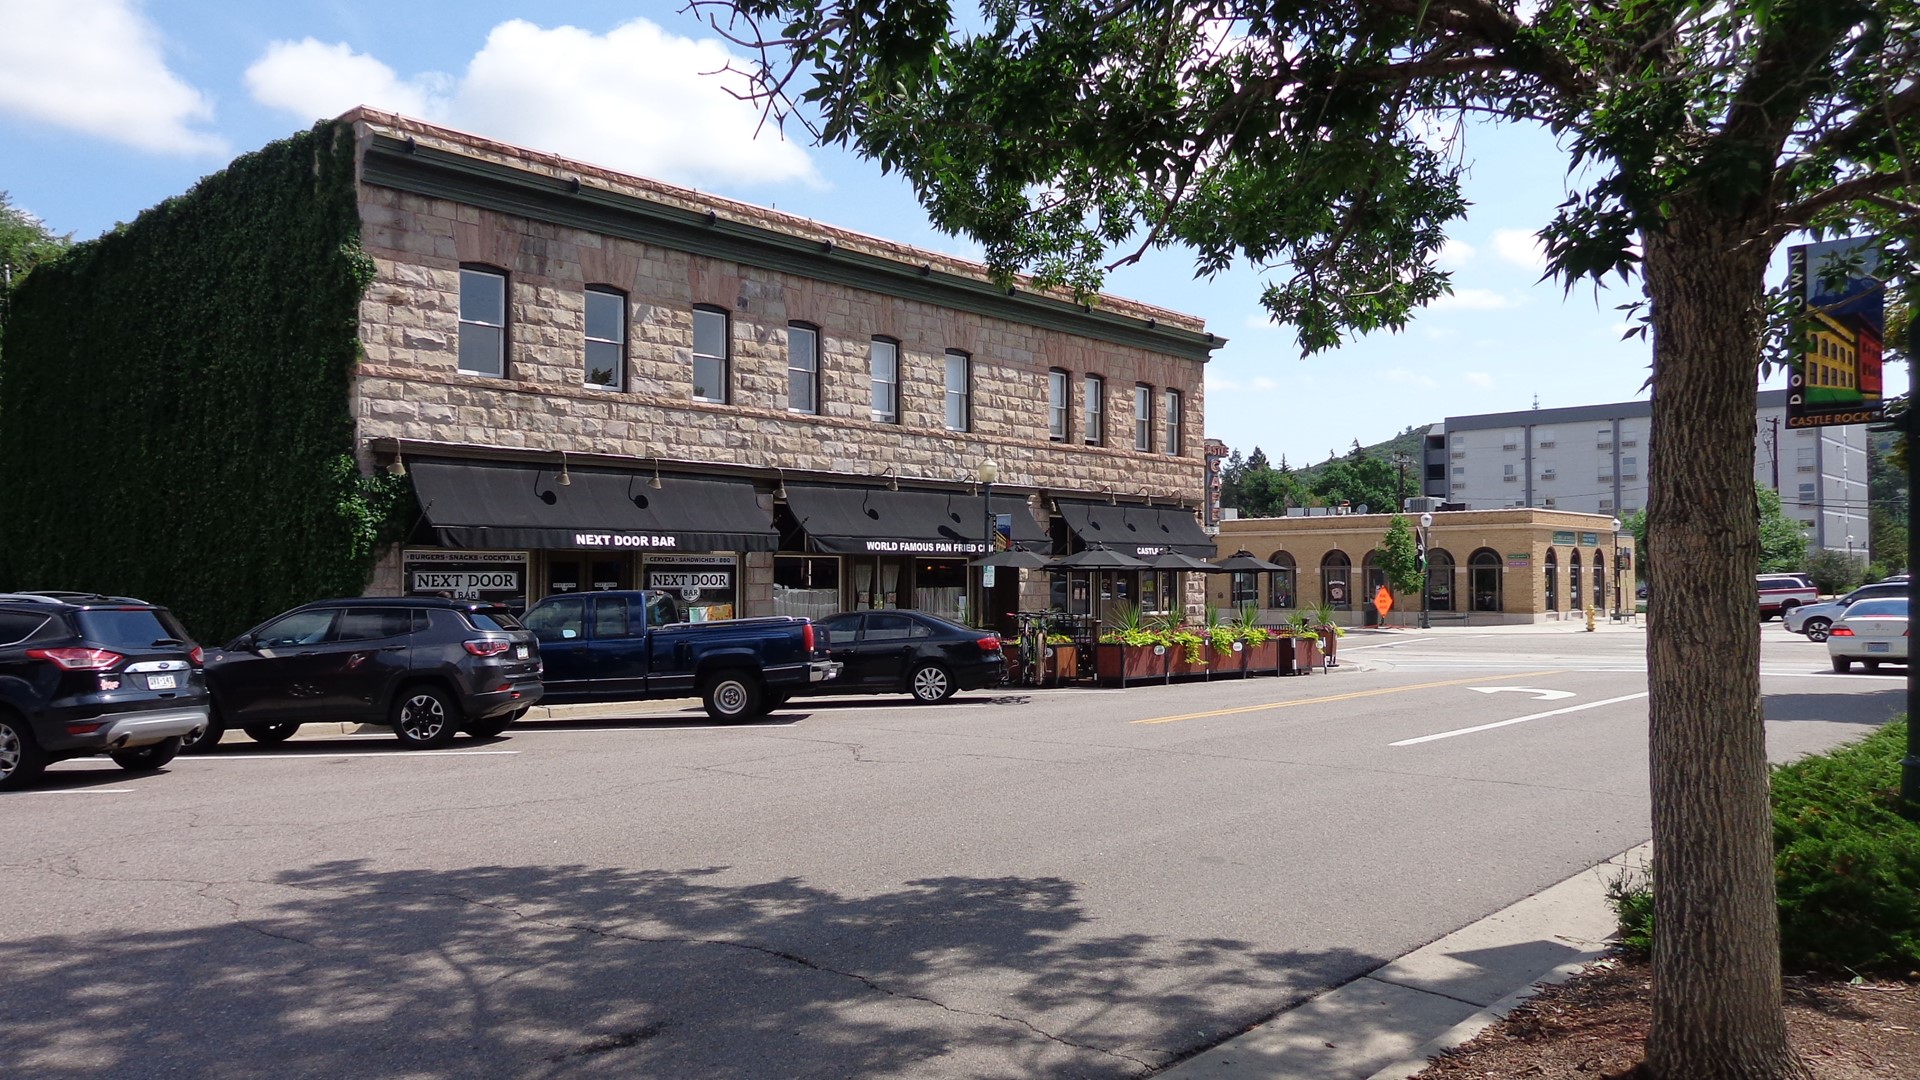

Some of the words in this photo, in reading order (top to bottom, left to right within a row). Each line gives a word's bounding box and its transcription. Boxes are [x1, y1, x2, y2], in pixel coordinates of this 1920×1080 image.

[1789, 416, 1831, 426] CASTLE
[1834, 412, 1870, 423] ROCK
[576, 534, 611, 545] NEXT
[614, 535, 649, 546] DOOR
[651, 536, 676, 547] BAR
[866, 541, 898, 550] WORLD
[900, 543, 934, 551] FAMOUS
[936, 544, 952, 552] PAN
[954, 544, 976, 552] FRIED
[417, 574, 463, 587] NEXT
[468, 574, 514, 587] DOOR
[652, 575, 688, 586] NEXT
[691, 575, 727, 586] DOOR
[457, 591, 477, 599] BAR
[683, 589, 699, 597] BAR
